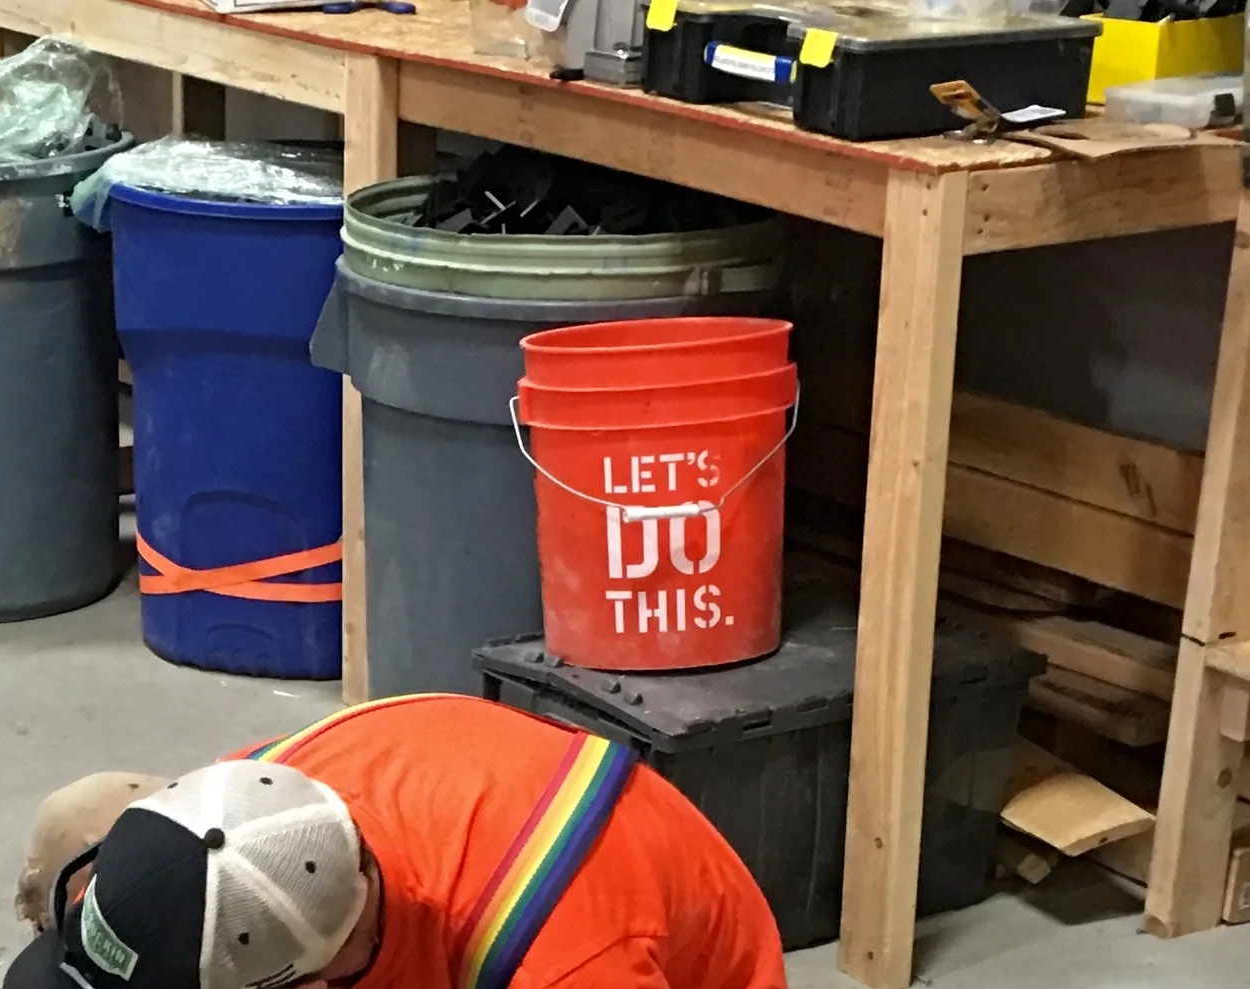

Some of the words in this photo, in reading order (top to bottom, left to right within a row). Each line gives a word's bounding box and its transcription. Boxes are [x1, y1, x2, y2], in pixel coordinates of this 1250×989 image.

[603, 449, 721, 494] LET'S
[606, 500, 722, 579] DO
[605, 584, 735, 634] THIS.
